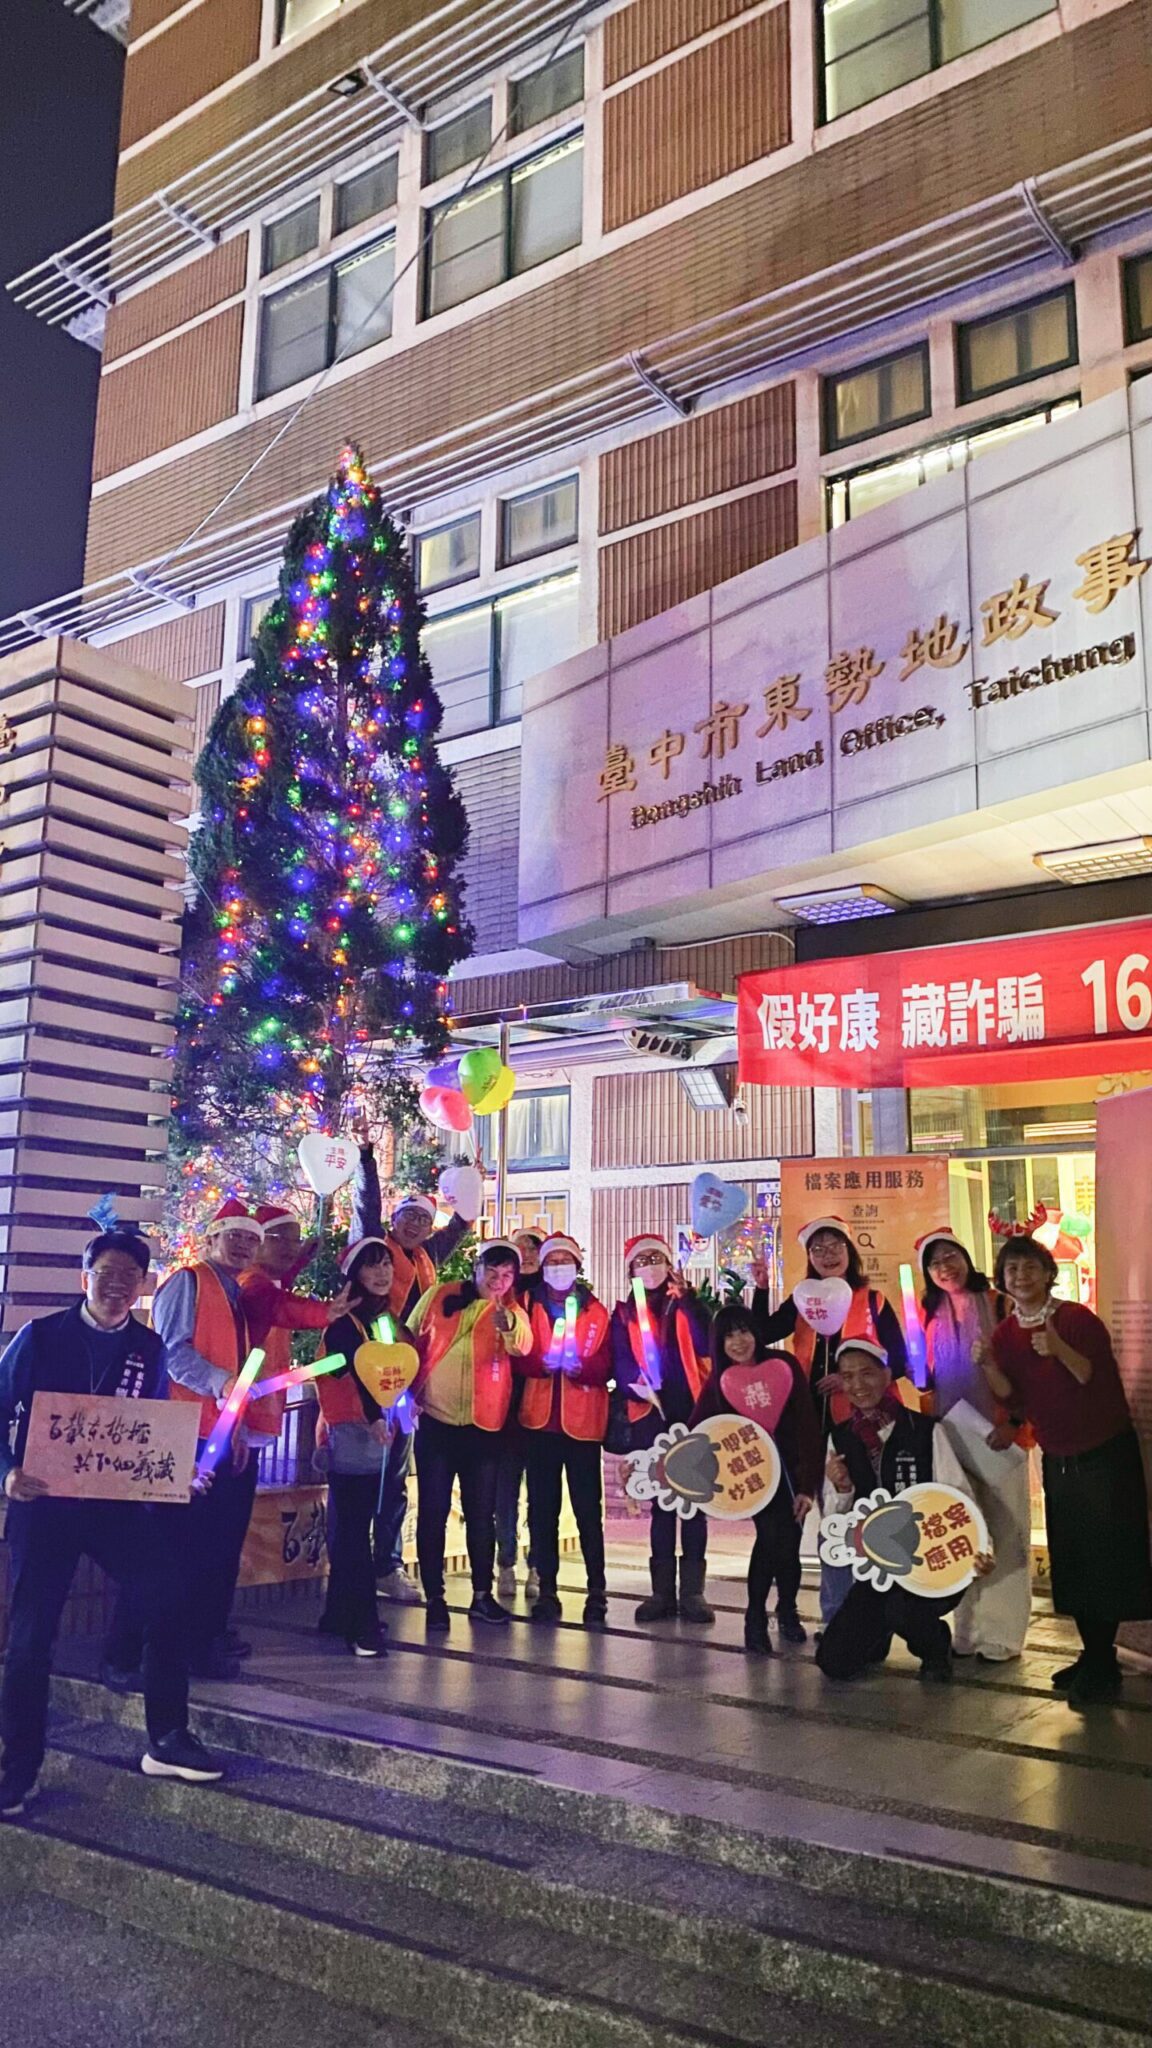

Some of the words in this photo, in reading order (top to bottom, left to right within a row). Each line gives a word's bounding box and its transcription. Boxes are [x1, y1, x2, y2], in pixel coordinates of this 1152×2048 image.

[630, 772, 743, 830] Dongshih
[755, 740, 824, 786] Land
[840, 704, 947, 757] Office,
[963, 631, 1136, 710] Taichung
[756, 988, 880, 1053] 假好康
[901, 972, 1045, 1048] 藏詐騙
[805, 1170, 924, 1191] 檔案應用服務
[852, 1204, 879, 1218] 查詢
[921, 1502, 972, 1540] 檔案
[924, 1534, 974, 1572] 應用
